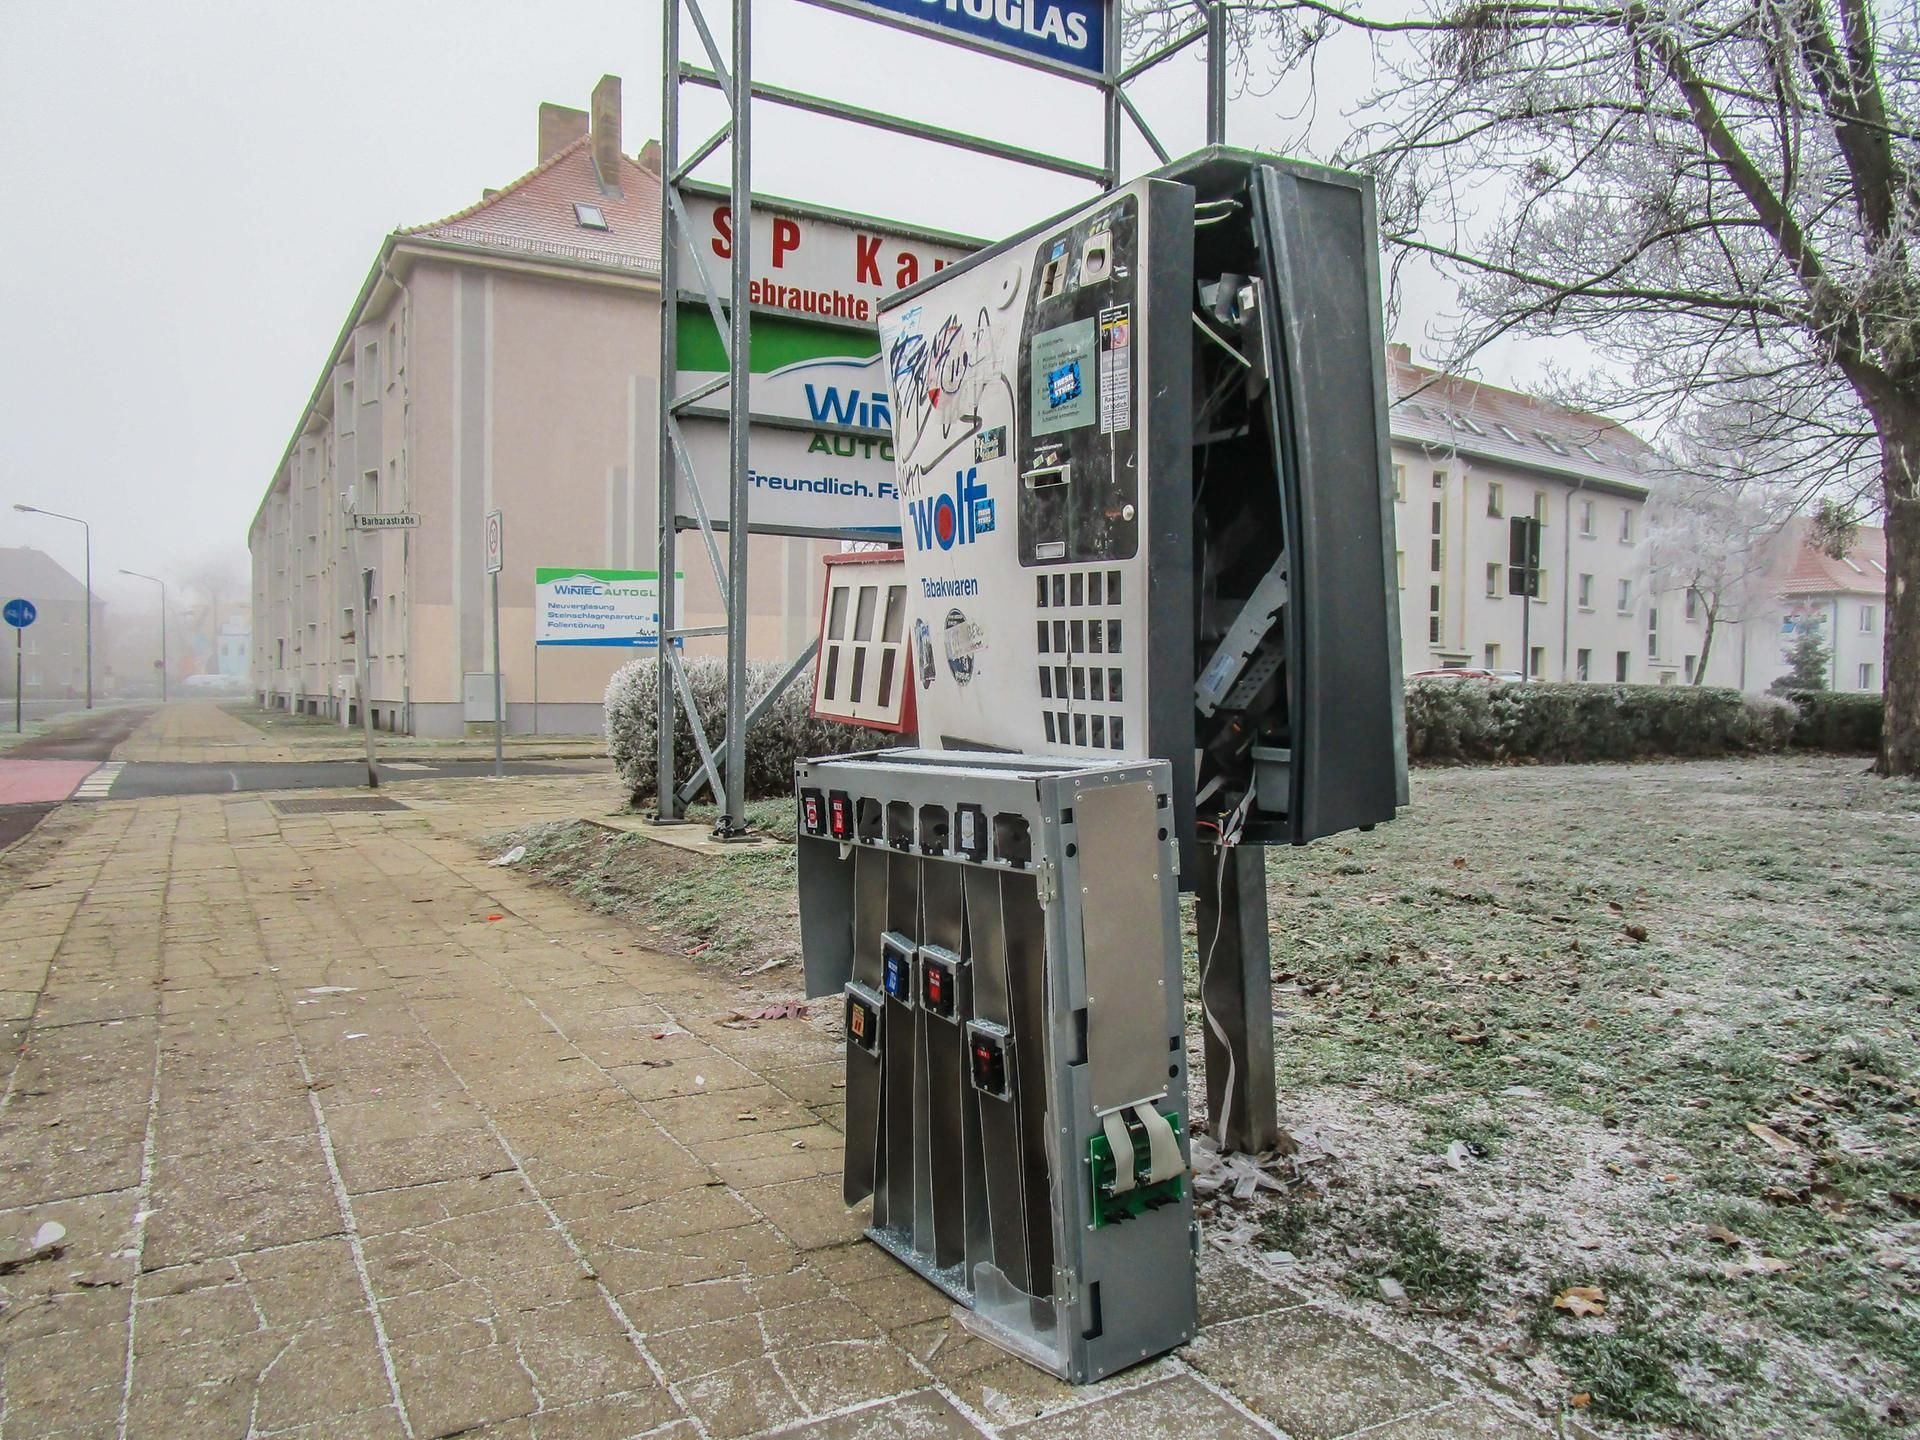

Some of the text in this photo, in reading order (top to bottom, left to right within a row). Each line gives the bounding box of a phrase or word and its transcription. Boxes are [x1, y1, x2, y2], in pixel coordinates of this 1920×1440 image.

[772, 217, 801, 269] P
[909, 467, 988, 551] wolf
[361, 516, 415, 527] Barbarastraße
[921, 577, 979, 598] Tabakwaren
[547, 602, 615, 611] Neuverglasung
[547, 611, 644, 621] Steinschlagreparatur
[547, 621, 605, 630] Folientönung
